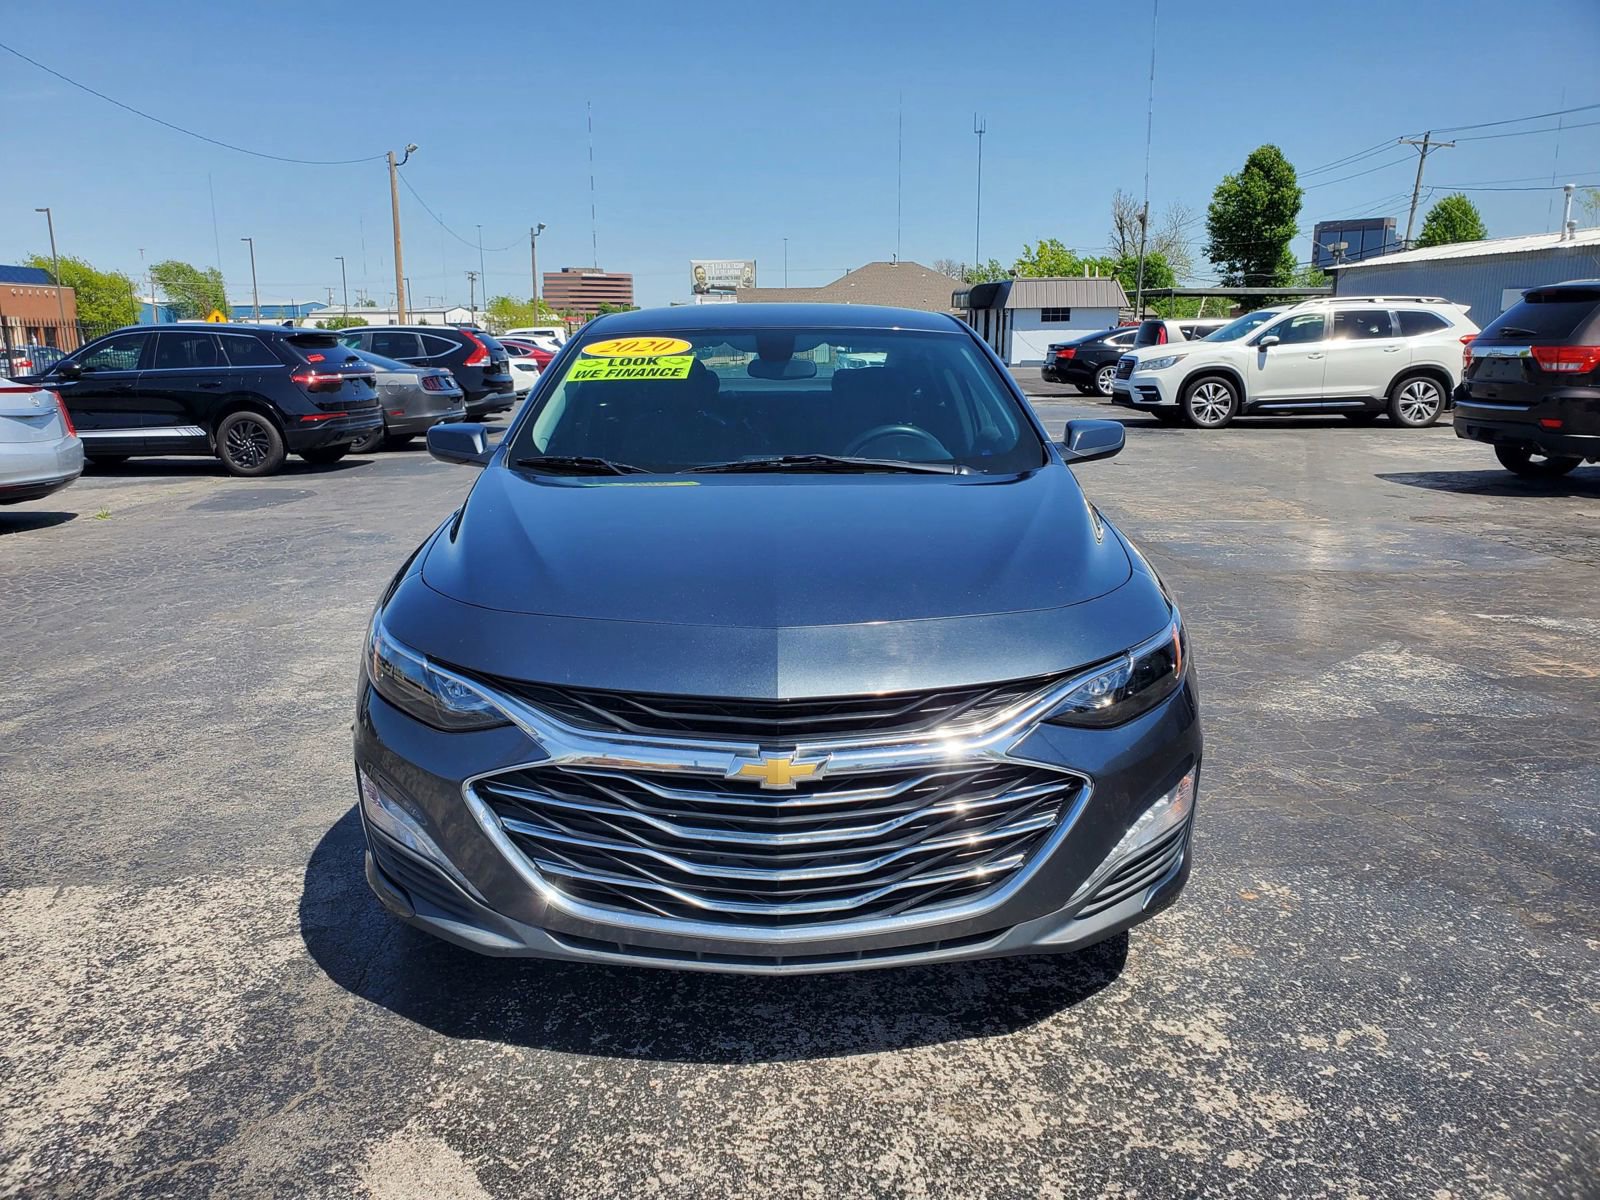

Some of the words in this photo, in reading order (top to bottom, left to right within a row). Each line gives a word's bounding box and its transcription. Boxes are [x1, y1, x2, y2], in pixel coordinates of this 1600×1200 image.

[597, 340, 675, 353] 2020
[607, 357, 660, 367] LOOK
[574, 369, 604, 380] WE
[605, 367, 684, 378] FINANCE
